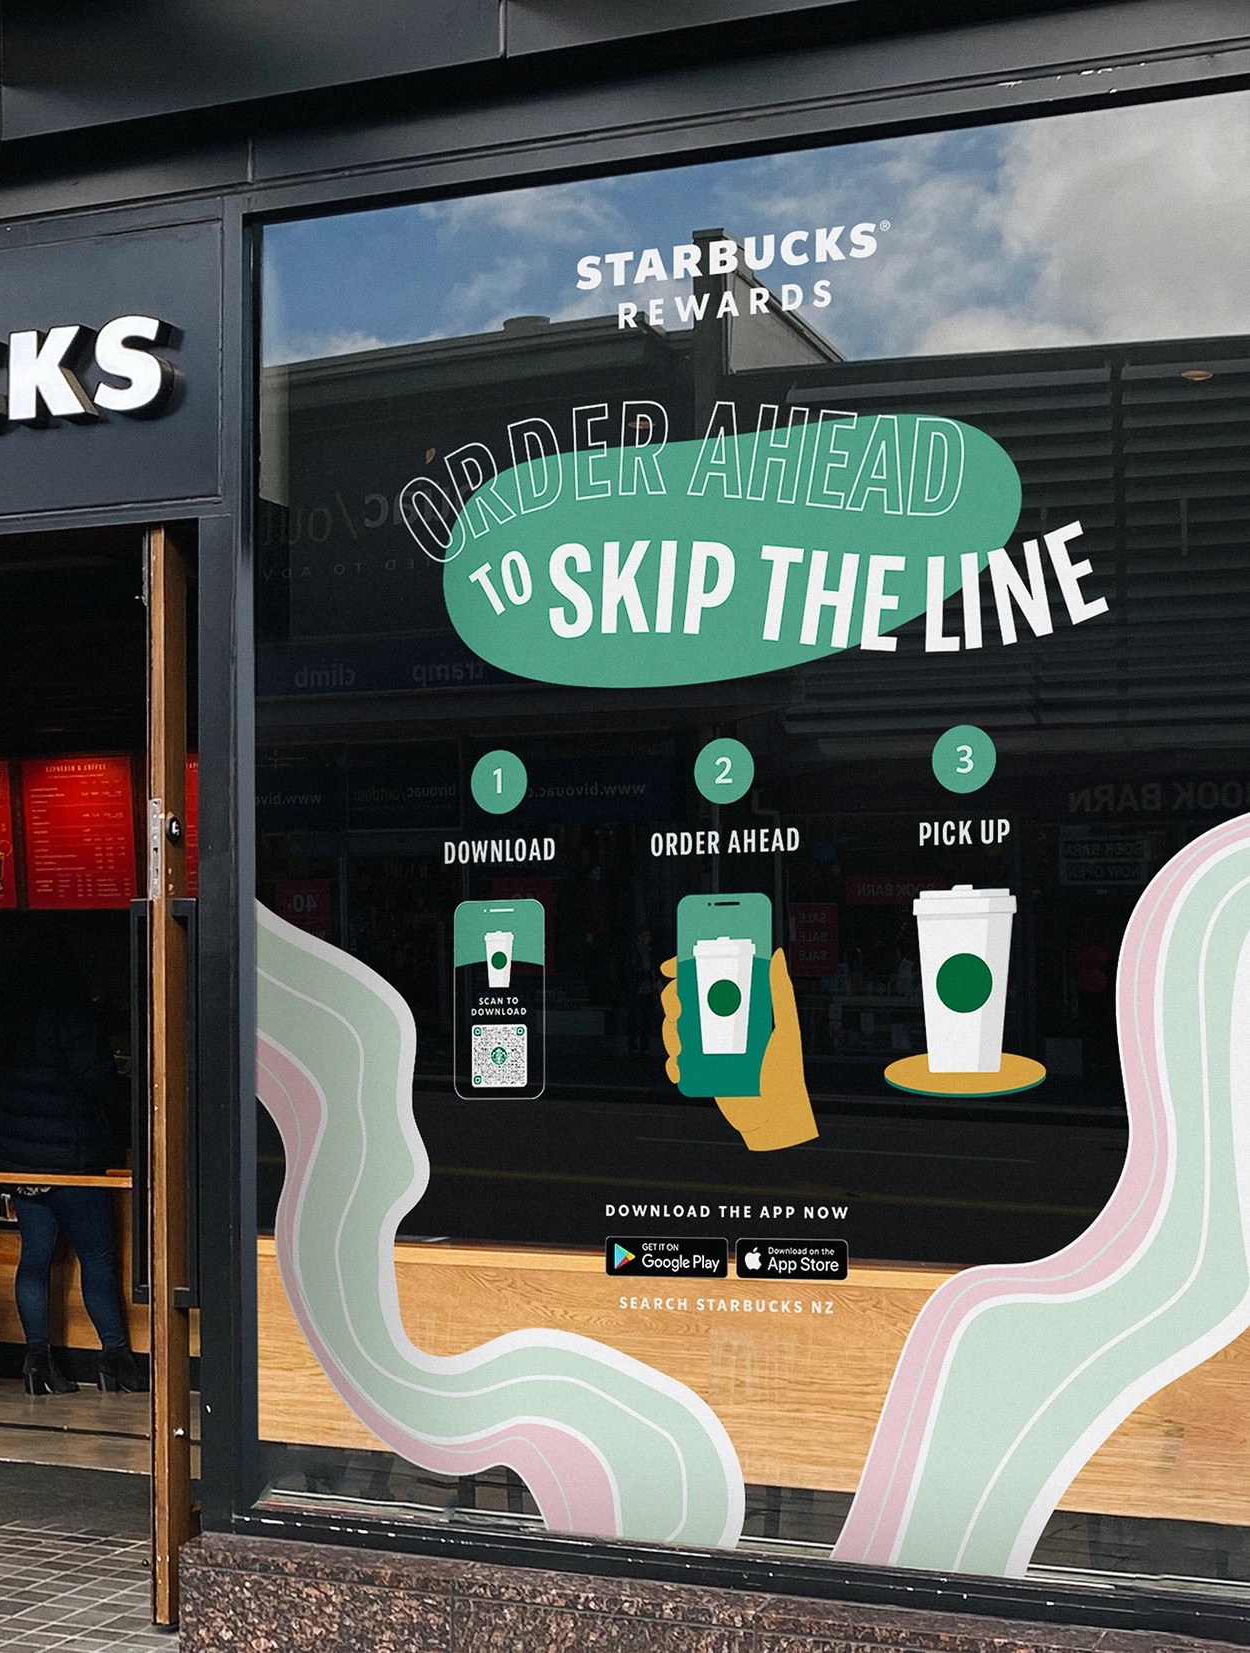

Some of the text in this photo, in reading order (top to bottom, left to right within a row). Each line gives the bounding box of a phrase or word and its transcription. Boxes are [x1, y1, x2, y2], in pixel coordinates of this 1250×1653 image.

[618, 279, 832, 329] REWARDS
[399, 400, 965, 562] ORDER AHEAD
[468, 520, 1109, 653] TO SKIP THE LINE
[714, 756, 733, 784] 2
[955, 744, 974, 774] 3
[492, 767, 503, 795] 1
[650, 827, 800, 857] ORDER AHEAD
[919, 818, 1011, 846] PICK UP
[444, 837, 556, 864] DOWNLOAD
[471, 1007, 527, 1016] DOWNLOAD
[479, 996, 519, 1006] SCAN TO
[605, 1204, 849, 1220] DOWNLOAD THE APP NOW
[642, 1243, 679, 1252] GET IT ON
[768, 1246, 835, 1256] Download on the
[642, 1253, 721, 1274] Google Play
[767, 1257, 840, 1274] App Store
[619, 1296, 834, 1314] SEARCH STARBUCKS NZ
